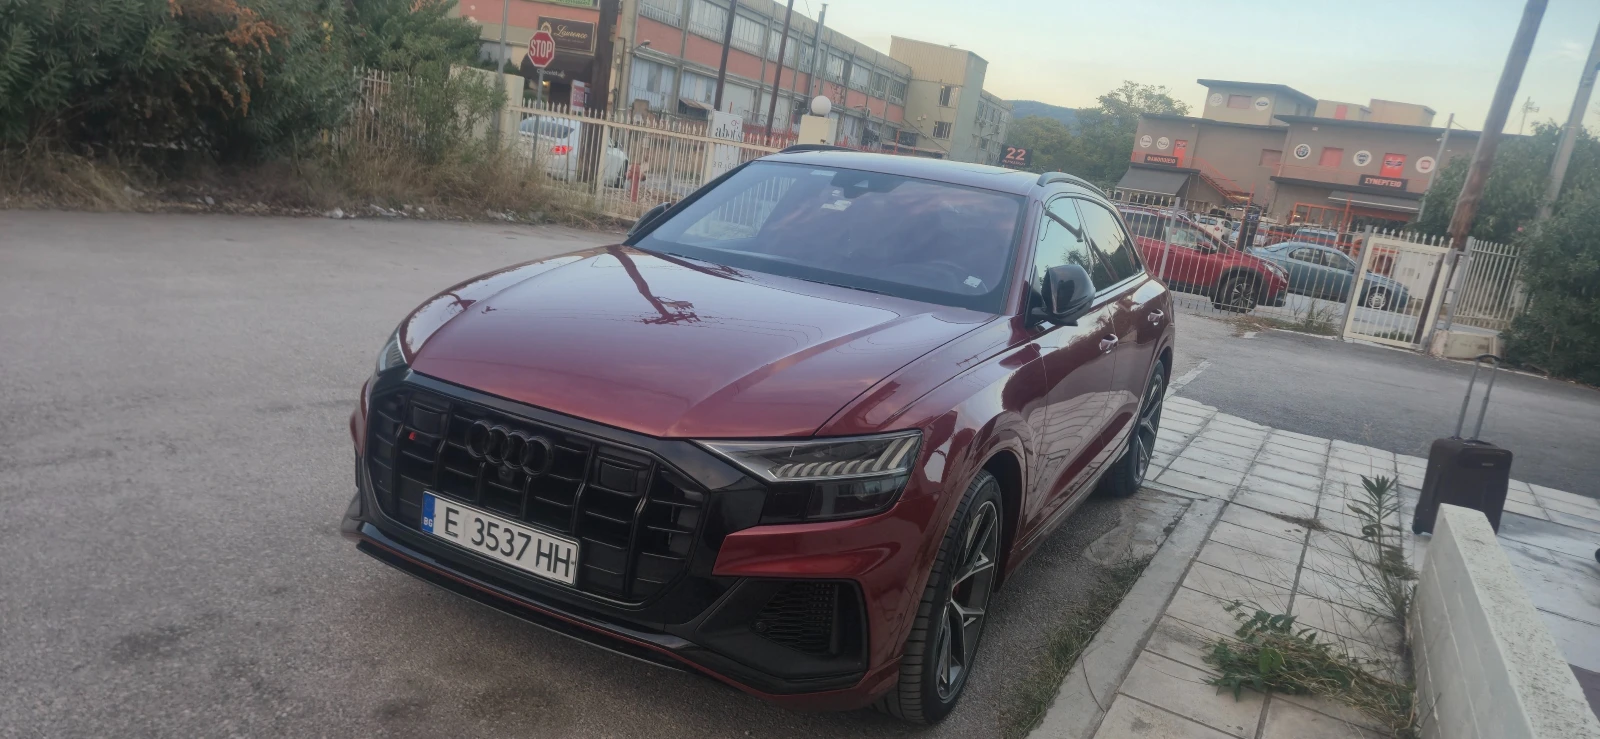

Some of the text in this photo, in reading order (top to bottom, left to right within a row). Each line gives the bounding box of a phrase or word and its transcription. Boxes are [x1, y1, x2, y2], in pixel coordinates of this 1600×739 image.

[554, 25, 588, 39] Laurence
[530, 39, 552, 58] STOP
[1005, 147, 1026, 161] 22
[1364, 177, 1402, 188] ΣΥΝΕΡΓΕΙΟ
[423, 516, 433, 528] BG
[444, 506, 572, 578] E 3537 HH
